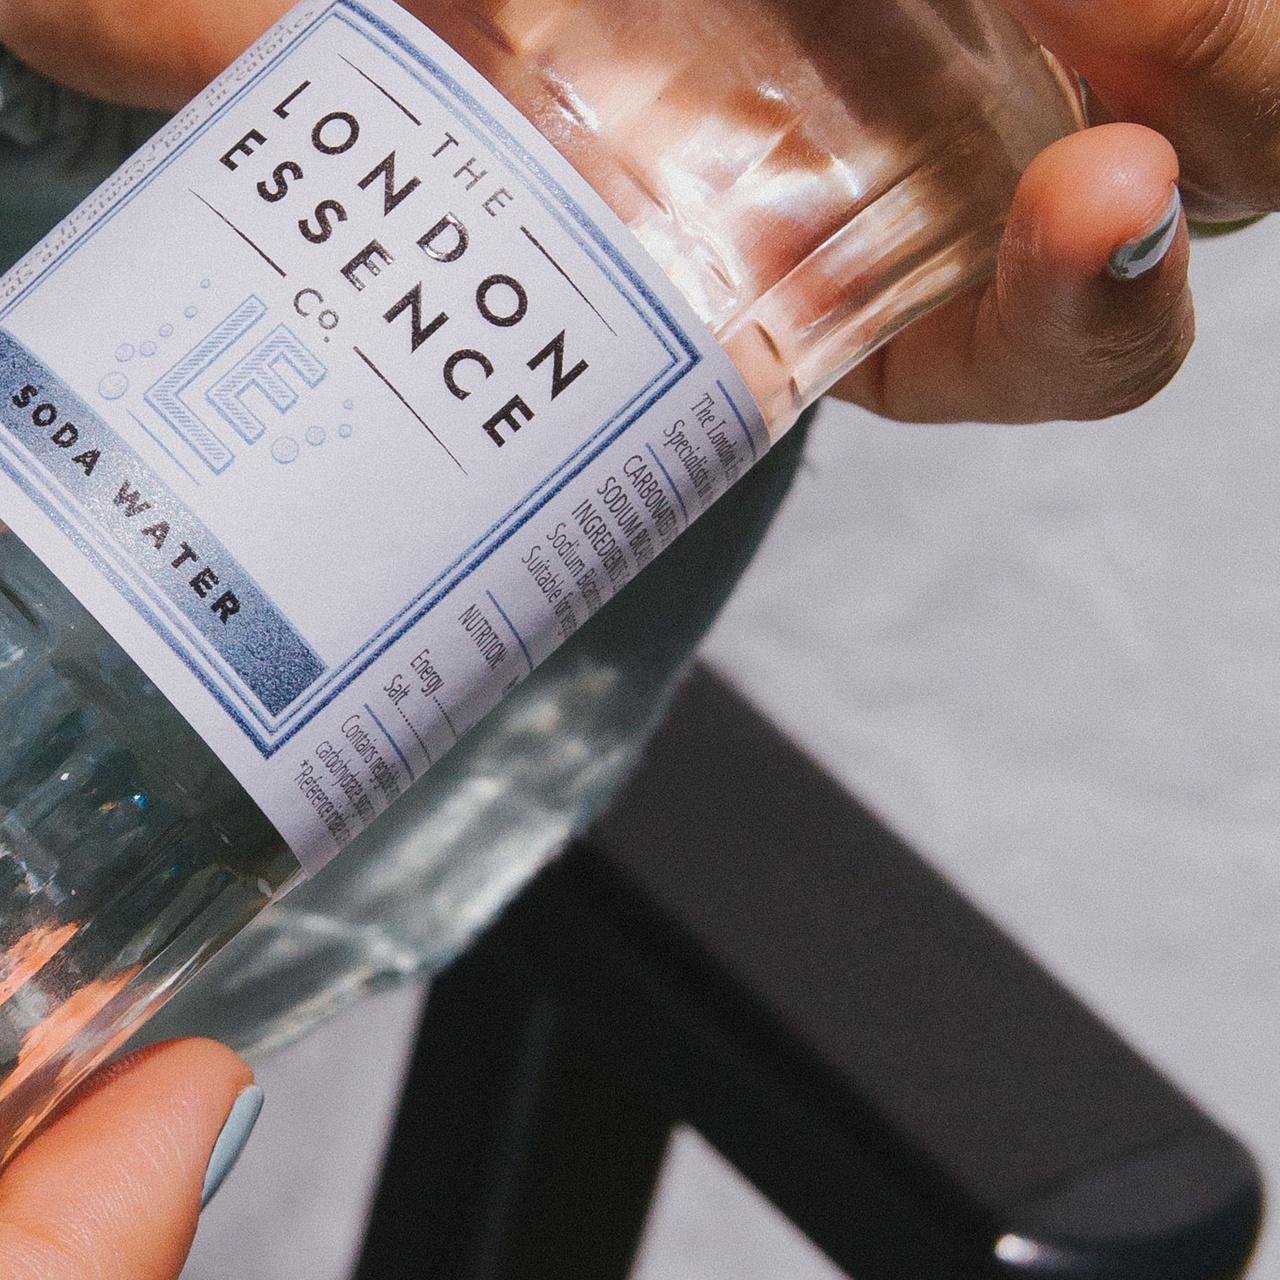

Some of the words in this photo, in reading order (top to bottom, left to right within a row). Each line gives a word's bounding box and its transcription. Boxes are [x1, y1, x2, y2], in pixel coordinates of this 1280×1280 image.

[432, 132, 514, 216] THE
[273, 80, 589, 401] LONDON
[219, 129, 535, 448] ESSENCE
[663, 419, 709, 488] Specialists
[690, 392, 716, 428] The
[706, 420, 738, 471] London
[12, 384, 100, 476] SODA
[113, 479, 240, 624] WATER
[597, 476, 643, 538] SODIUM
[623, 455, 677, 536] CARBONATED
[521, 545, 565, 604] Suitable
[553, 592, 573, 618] for
[546, 522, 585, 578] Sodium
[383, 674, 411, 706] Salt
[410, 648, 445, 697] Energy
[341, 714, 379, 764] Contains
